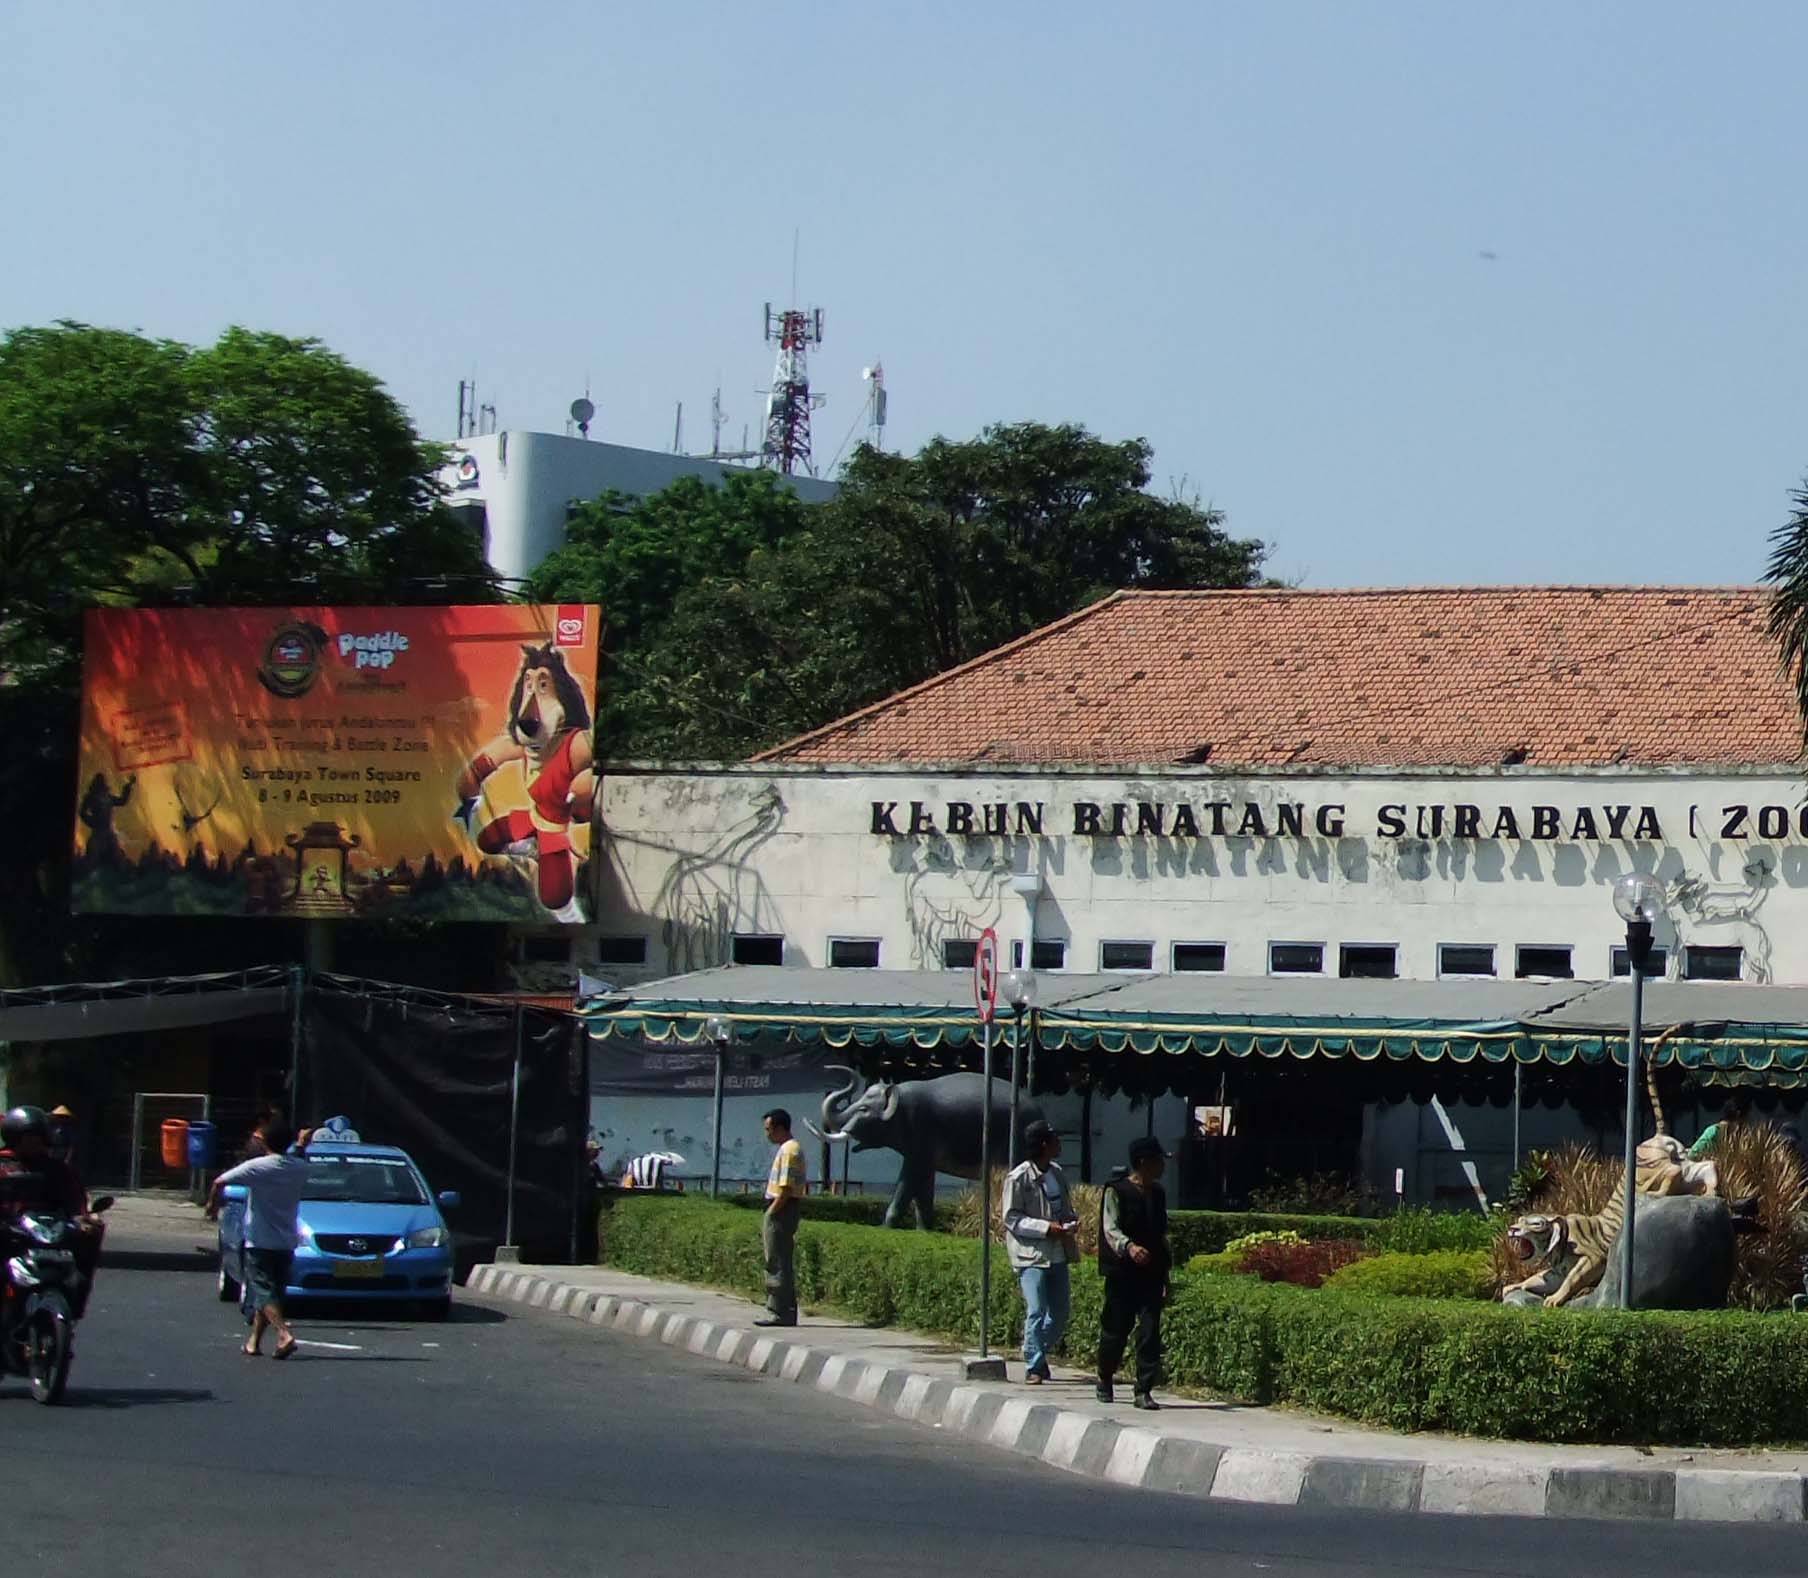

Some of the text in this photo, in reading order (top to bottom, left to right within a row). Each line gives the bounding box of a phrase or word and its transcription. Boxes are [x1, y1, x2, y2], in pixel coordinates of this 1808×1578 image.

[392, 737, 429, 751] Zone
[241, 766, 421, 784] Surabaya Town Square
[296, 788, 358, 807] Agustus
[365, 789, 401, 804] 2009
[870, 801, 1044, 835] KEBUN
[1073, 802, 1345, 837] BINATANG
[1376, 804, 1663, 839] SURABAYA
